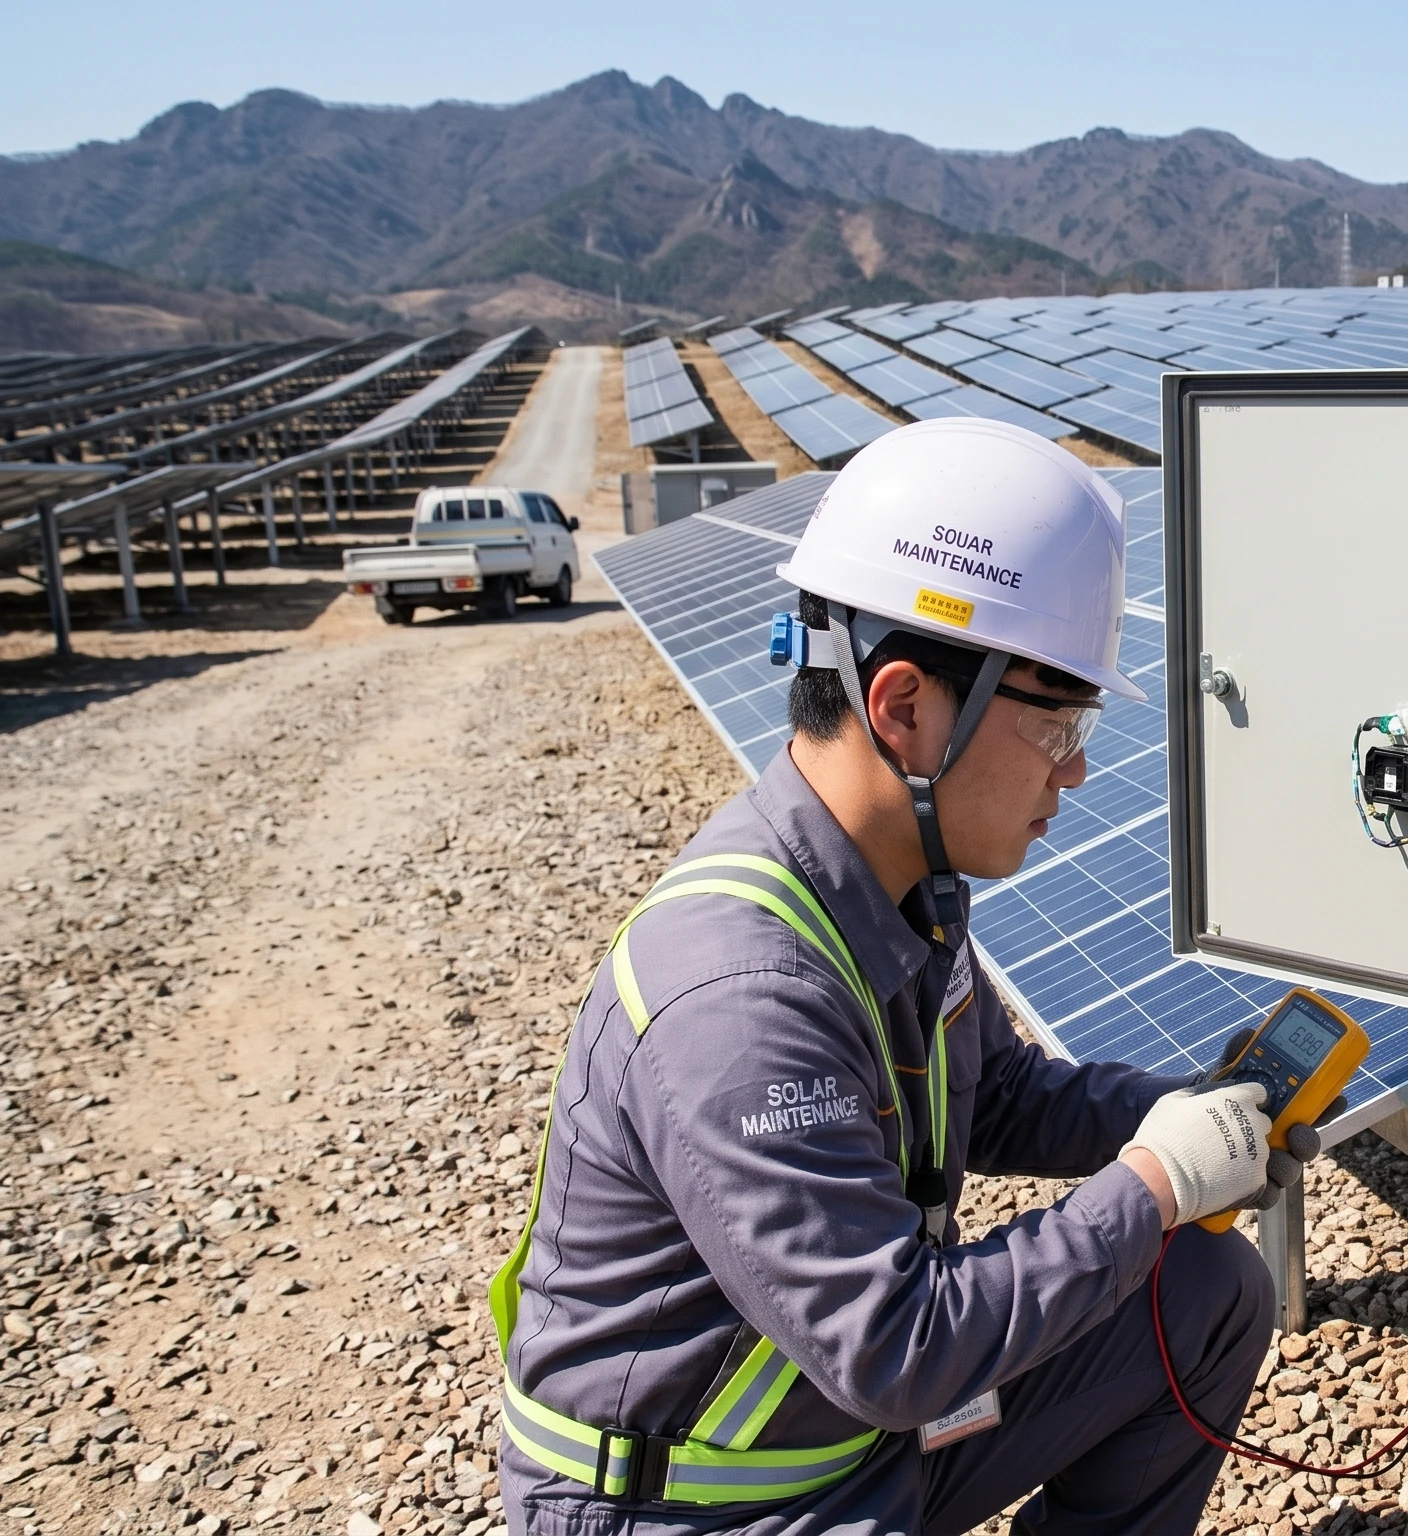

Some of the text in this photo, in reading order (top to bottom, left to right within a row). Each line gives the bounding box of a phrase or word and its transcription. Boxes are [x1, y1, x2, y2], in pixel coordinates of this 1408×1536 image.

[932, 525, 994, 556] SOUAR
[893, 538, 1023, 590] MAINTENANCE
[767, 1076, 838, 1107] SOLAR
[741, 1094, 860, 1137] MAINTENANCE
